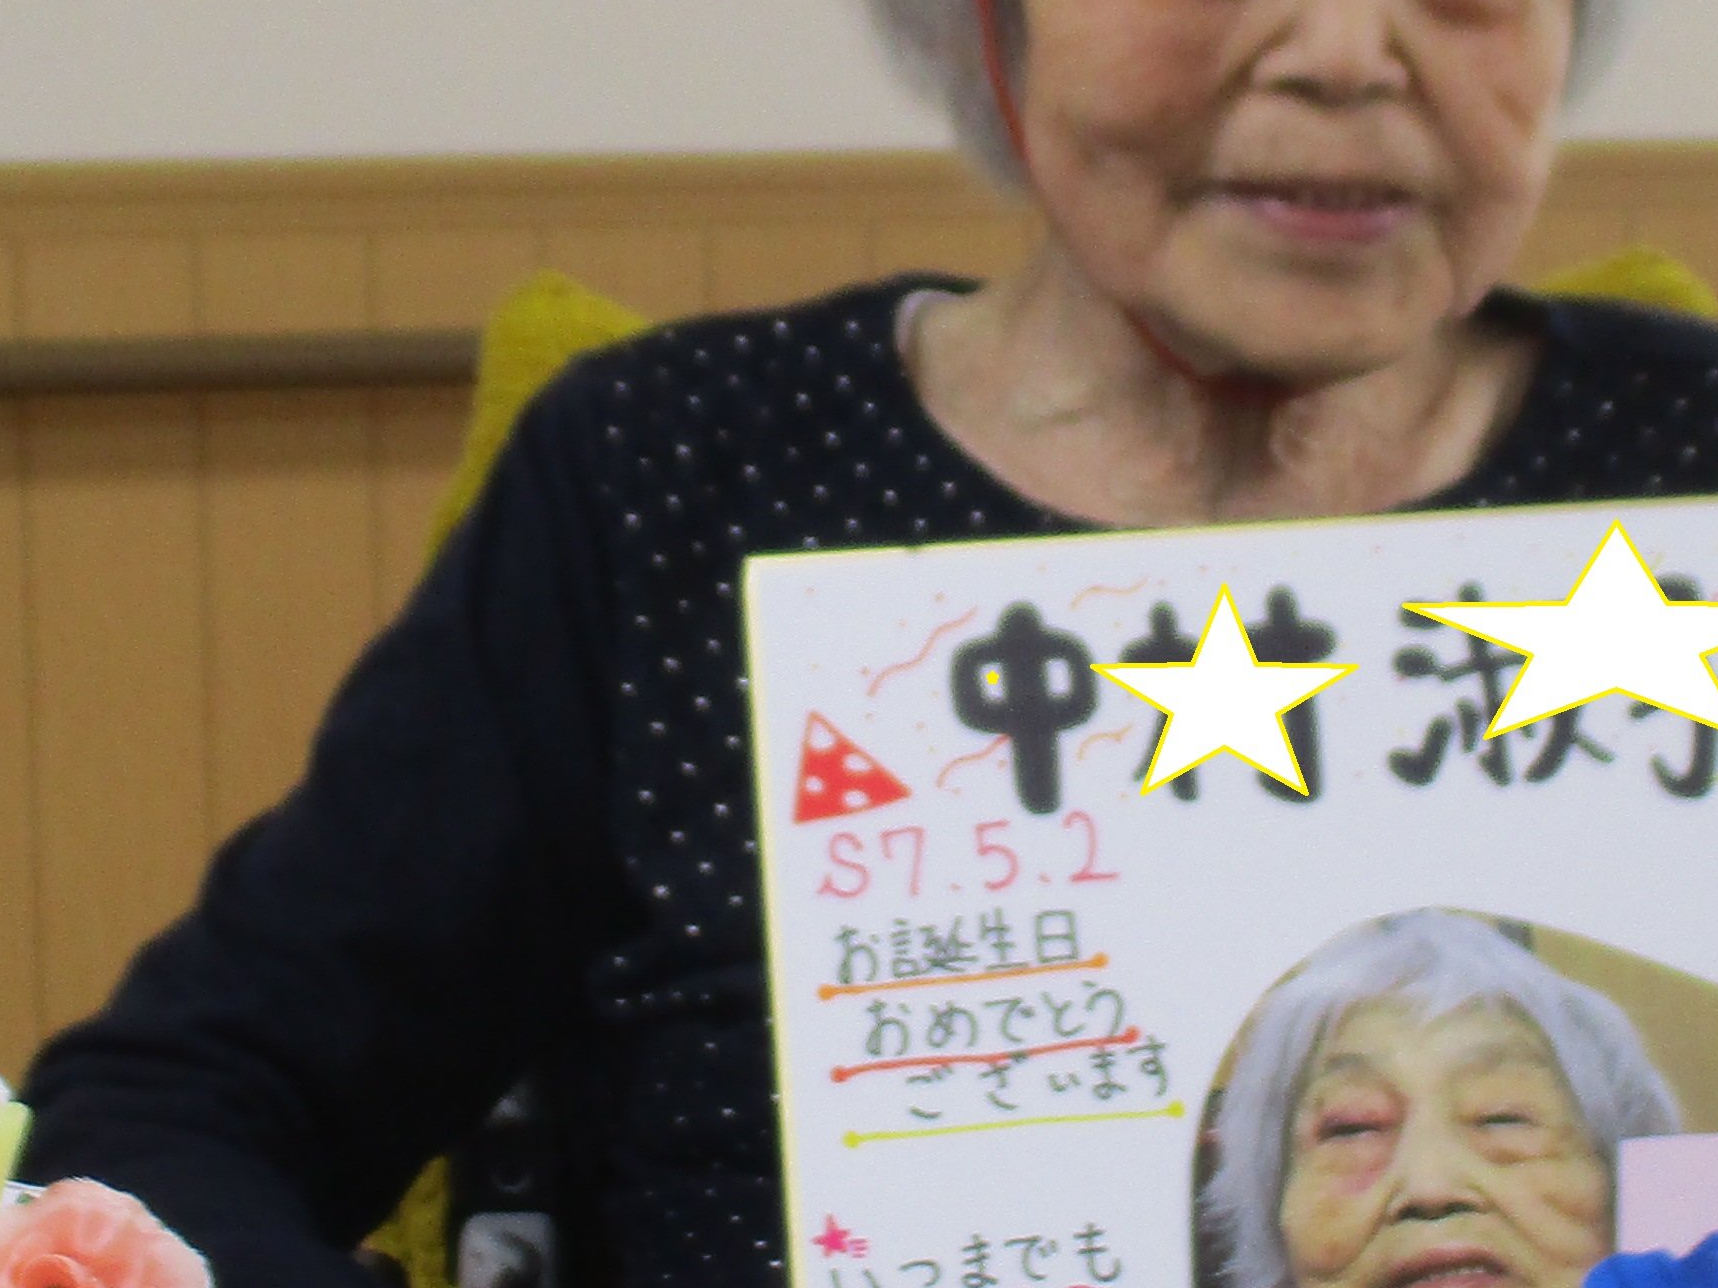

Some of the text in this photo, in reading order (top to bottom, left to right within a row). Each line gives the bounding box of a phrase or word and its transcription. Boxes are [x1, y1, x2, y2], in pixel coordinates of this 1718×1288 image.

[817, 810, 1120, 899] S7.5.2
[835, 908, 1081, 986] お誕生日
[864, 980, 1125, 1058] おめでとう
[905, 1035, 1169, 1120] ございます
